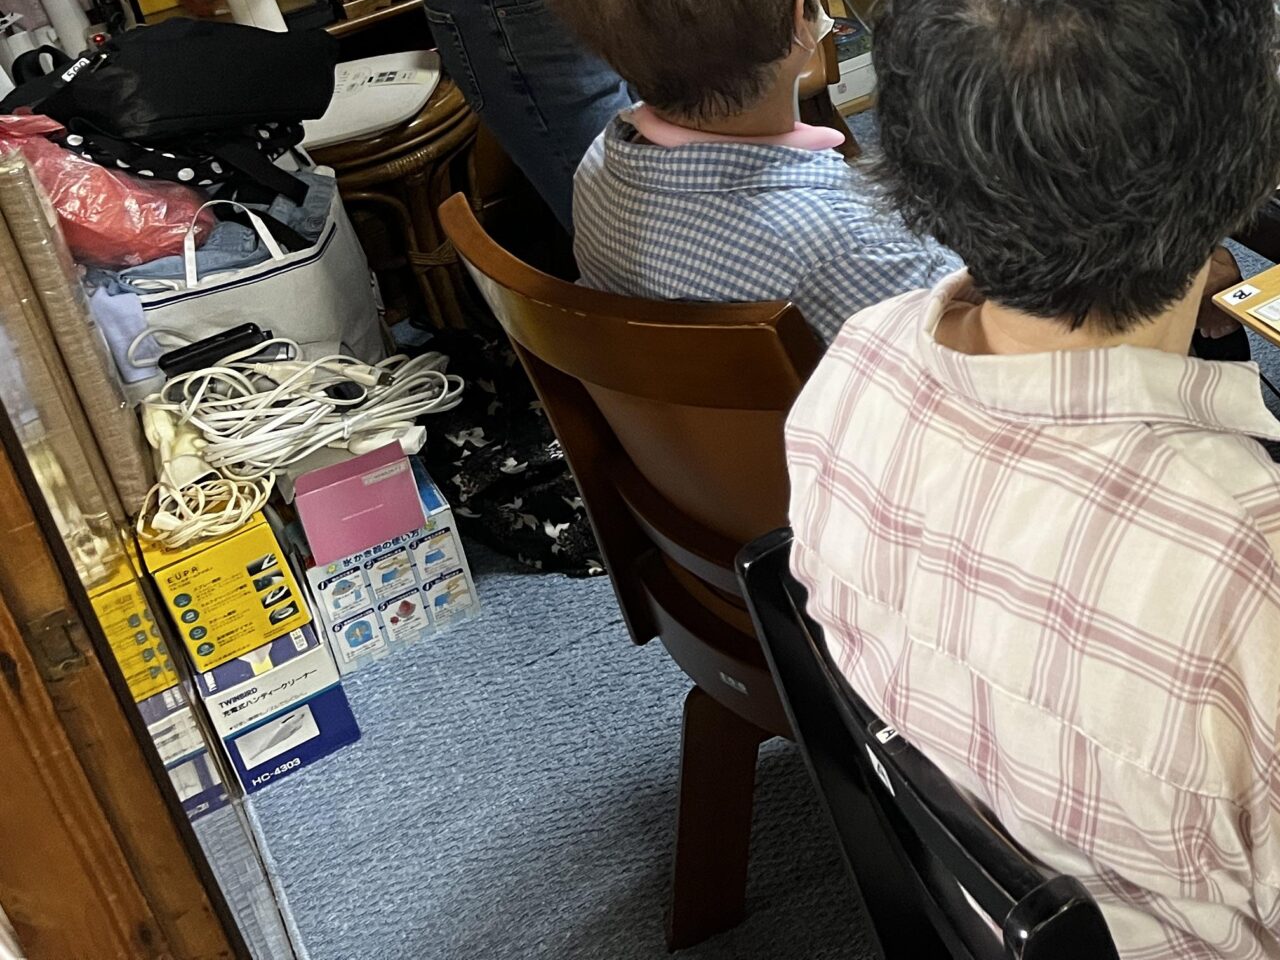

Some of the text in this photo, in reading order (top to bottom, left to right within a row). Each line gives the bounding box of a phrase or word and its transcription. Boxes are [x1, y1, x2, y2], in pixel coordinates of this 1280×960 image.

[342, 528, 421, 569] 氷かき器の使い方
[166, 565, 199, 584] EUPA
[218, 687, 258, 709] TWINBIRD
[221, 668, 318, 718] 充電式ハンディークリーナー
[251, 757, 301, 787] HC-4303
